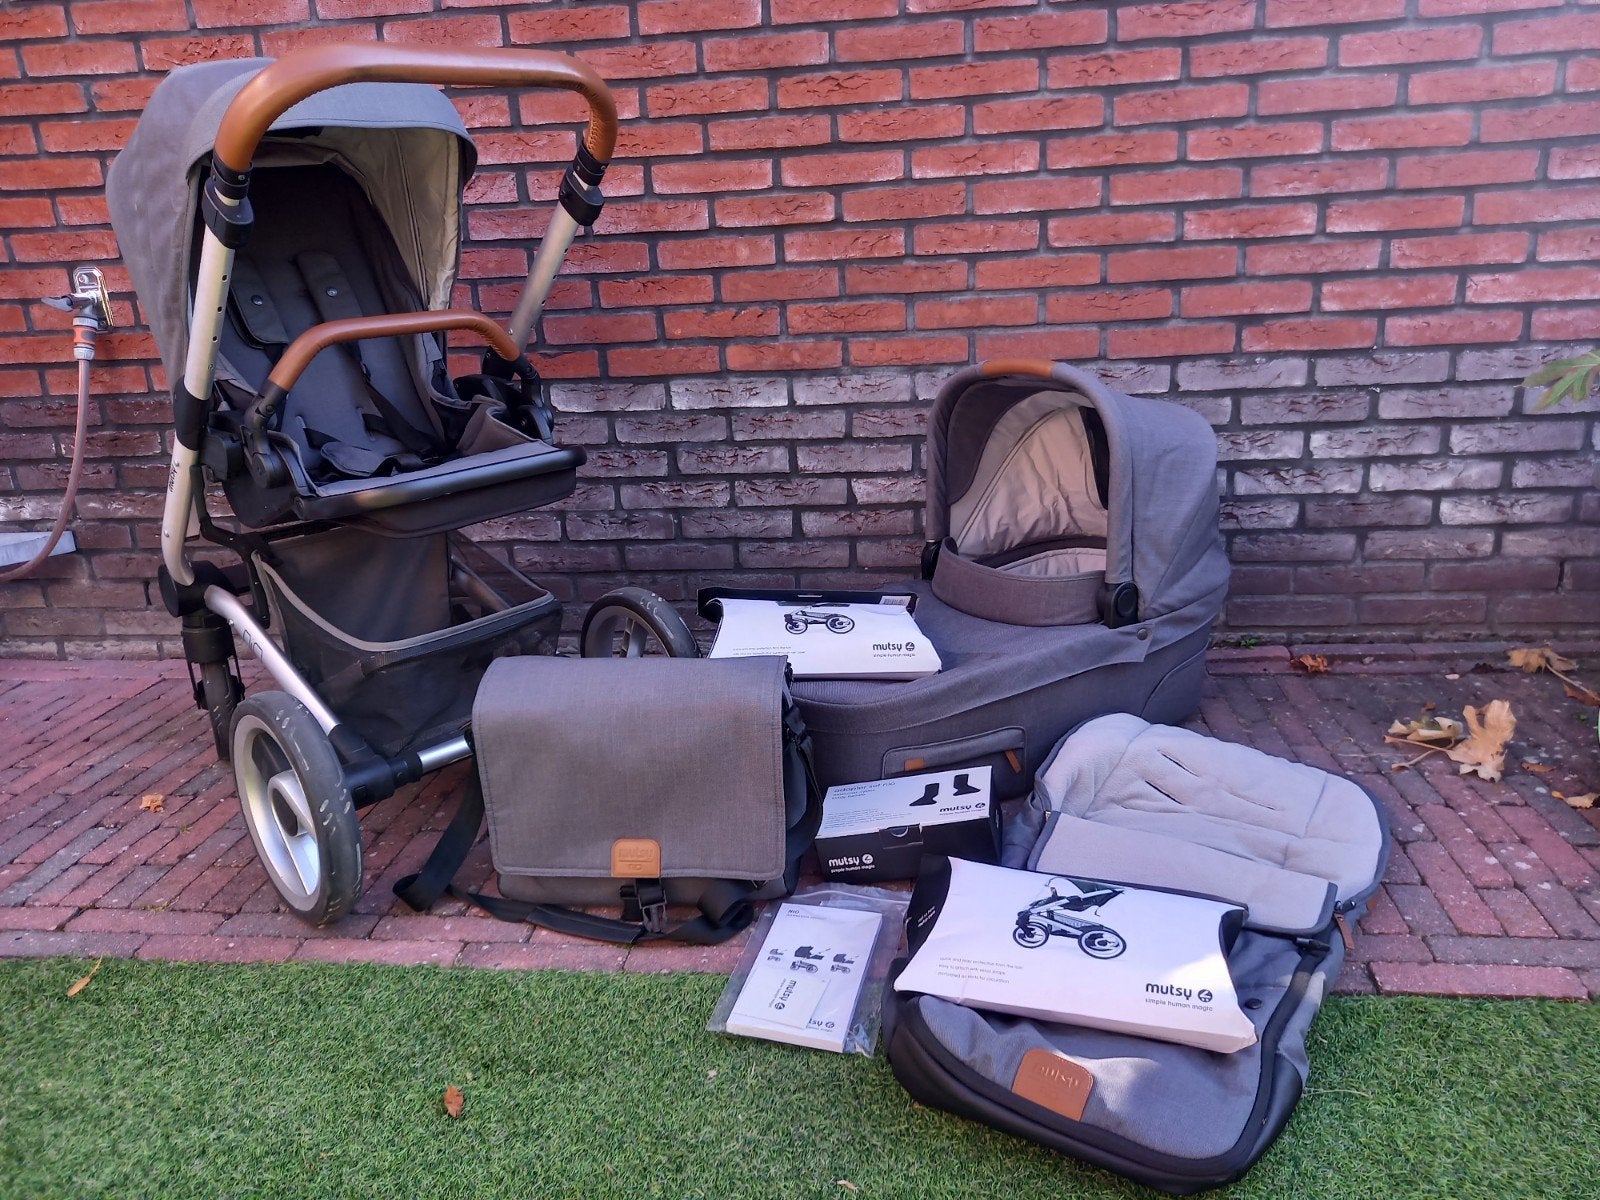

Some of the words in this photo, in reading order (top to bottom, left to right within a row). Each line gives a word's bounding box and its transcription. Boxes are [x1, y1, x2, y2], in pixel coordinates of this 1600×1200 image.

[872, 642, 903, 652] mutsy
[939, 804, 972, 813] mutsy
[828, 856, 860, 867] mutsy
[779, 979, 797, 1001] mutsy
[1145, 983, 1192, 1001] mutsy
[1167, 1000, 1191, 1008] human
